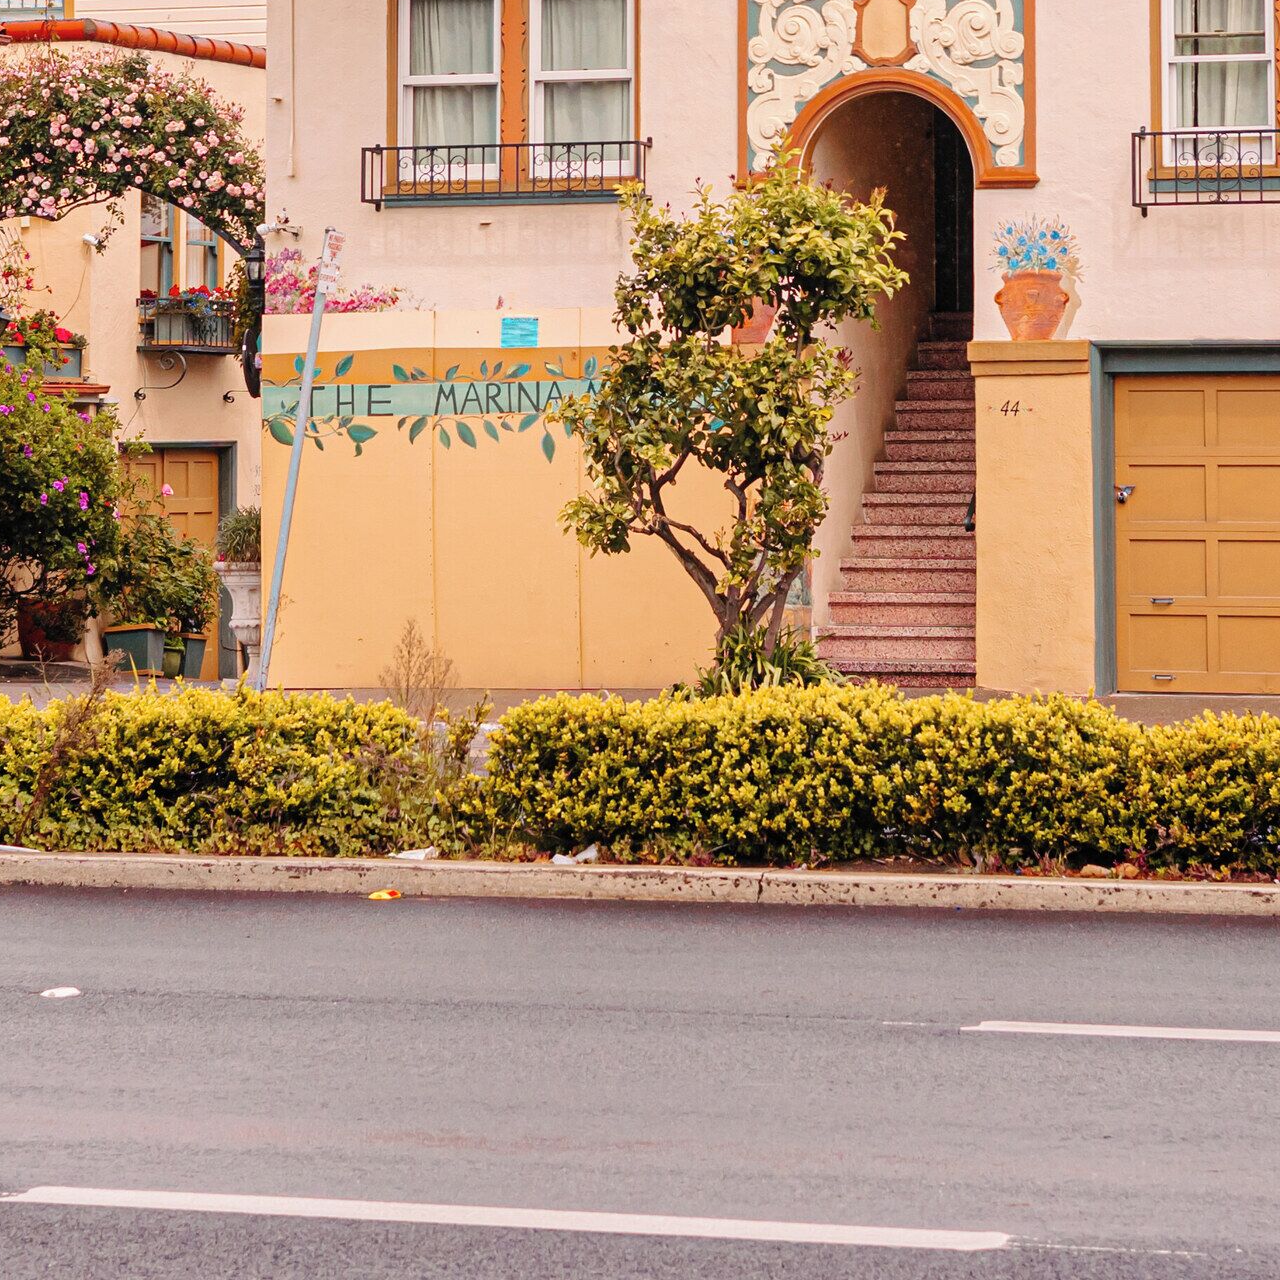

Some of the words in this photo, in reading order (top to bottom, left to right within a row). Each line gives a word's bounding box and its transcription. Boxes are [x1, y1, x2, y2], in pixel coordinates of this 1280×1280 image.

[299, 384, 394, 417] THE
[434, 381, 562, 414] MARINA
[1000, 399, 1020, 417] 44
